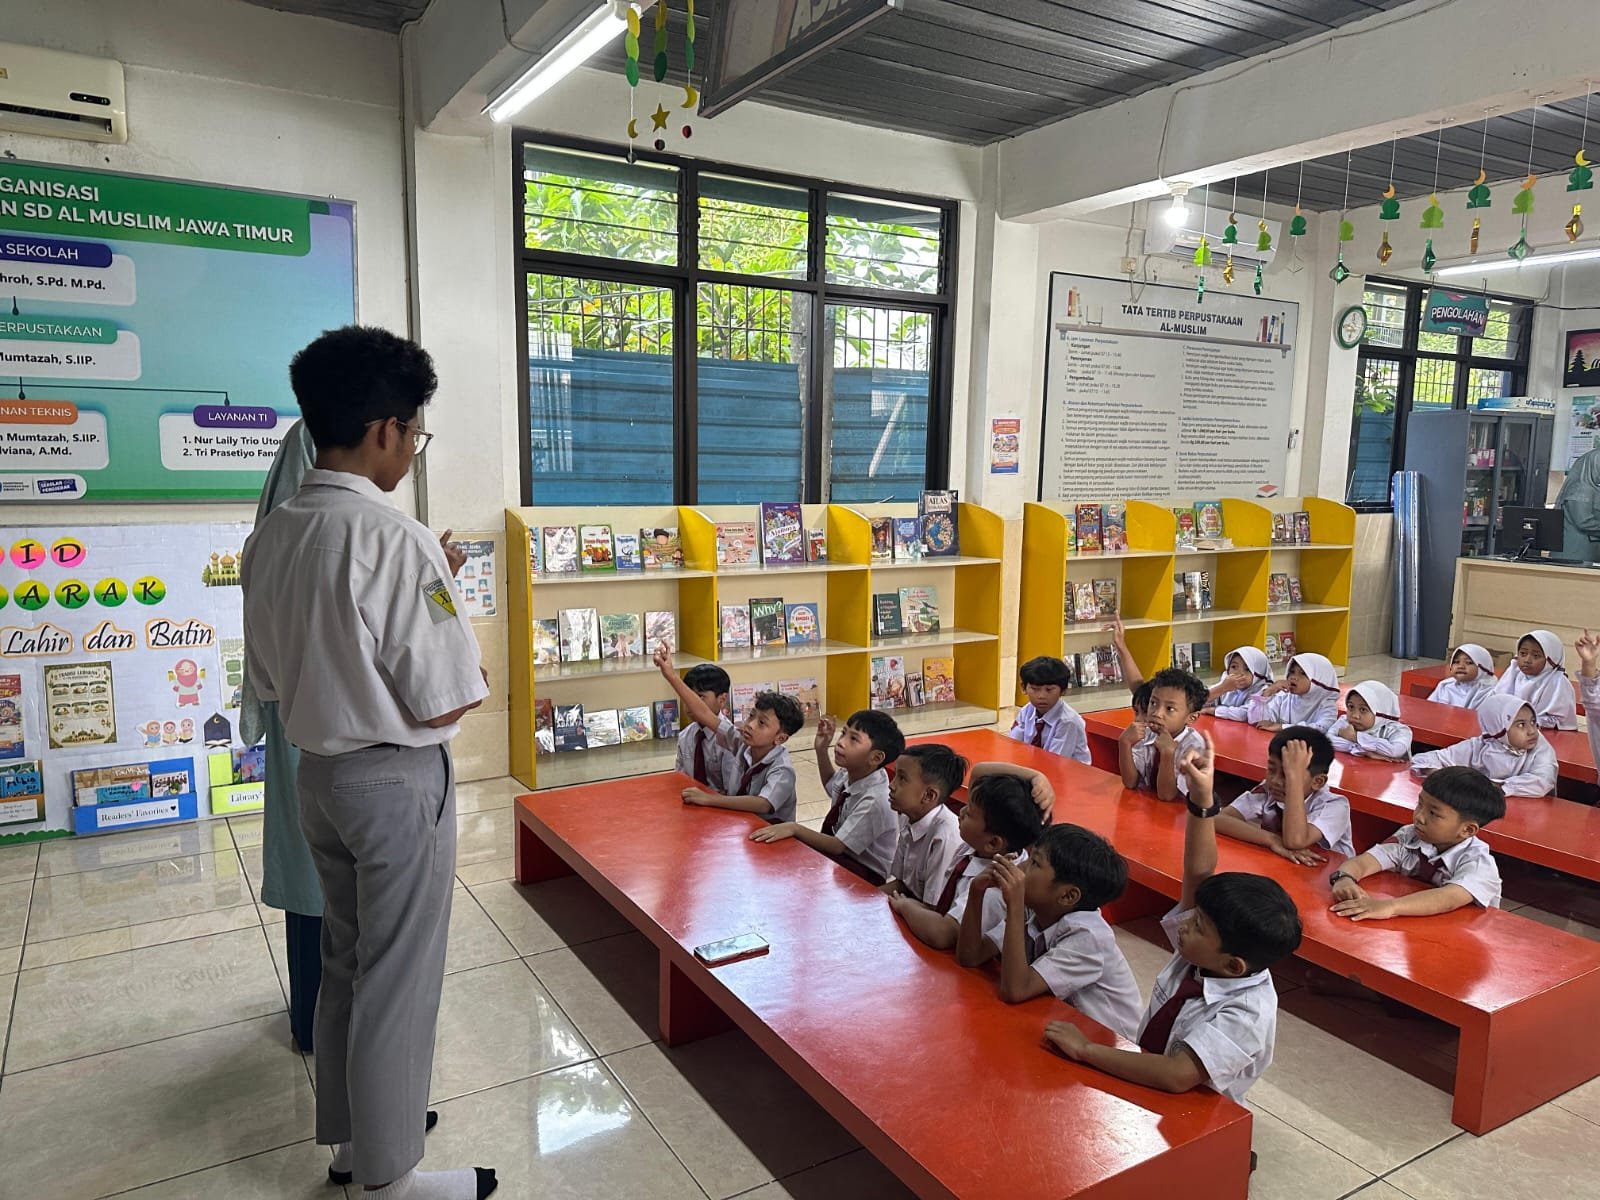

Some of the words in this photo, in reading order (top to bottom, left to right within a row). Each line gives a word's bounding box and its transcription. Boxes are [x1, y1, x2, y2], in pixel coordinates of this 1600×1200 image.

[0, 177, 99, 201] GANISASI
[23, 202, 52, 218] SD
[58, 206, 85, 222] AL
[89, 208, 171, 231] MUSLIM
[175, 218, 230, 237] JAWA
[232, 223, 294, 243] TIMUR
[6, 243, 79, 260] SEKOLAH
[36, 275, 67, 288] S.Pd.
[71, 278, 106, 290] M.Pd.
[1121, 304, 1143, 316] TATA
[1146, 306, 1176, 319] TERTIB
[1179, 310, 1243, 326] PERPUSTAKAAN
[1431, 307, 1485, 325] PENGOLAHAN
[0, 321, 102, 337] ERPUSTAKAAN
[1160, 322, 1207, 335] AL-MUSLIM
[65, 354, 96, 366] S.IIP.
[0, 407, 27, 416] NAN
[30, 407, 72, 417] TEKNIS
[208, 412, 255, 422] LAYANAN
[258, 413, 267, 422] TI
[7, 433, 69, 443] Mumtazah,
[72, 433, 100, 443] S.IIP.
[183, 436, 191, 444] 1.
[194, 436, 213, 445] Nur
[216, 436, 238, 447] Laily
[240, 437, 259, 445] Trio
[39, 446, 72, 456] A.Md.
[183, 448, 192, 457] 2.
[194, 448, 208, 457] Tri
[210, 448, 255, 459] Prasetiyo
[928, 496, 948, 505] ATLAS
[753, 600, 783, 618] Why?
[4, 625, 69, 654] Lahir
[87, 622, 133, 649] dan
[150, 620, 212, 647] Batin
[101, 809, 135, 822] Readers'
[136, 806, 168, 817] Favorites
